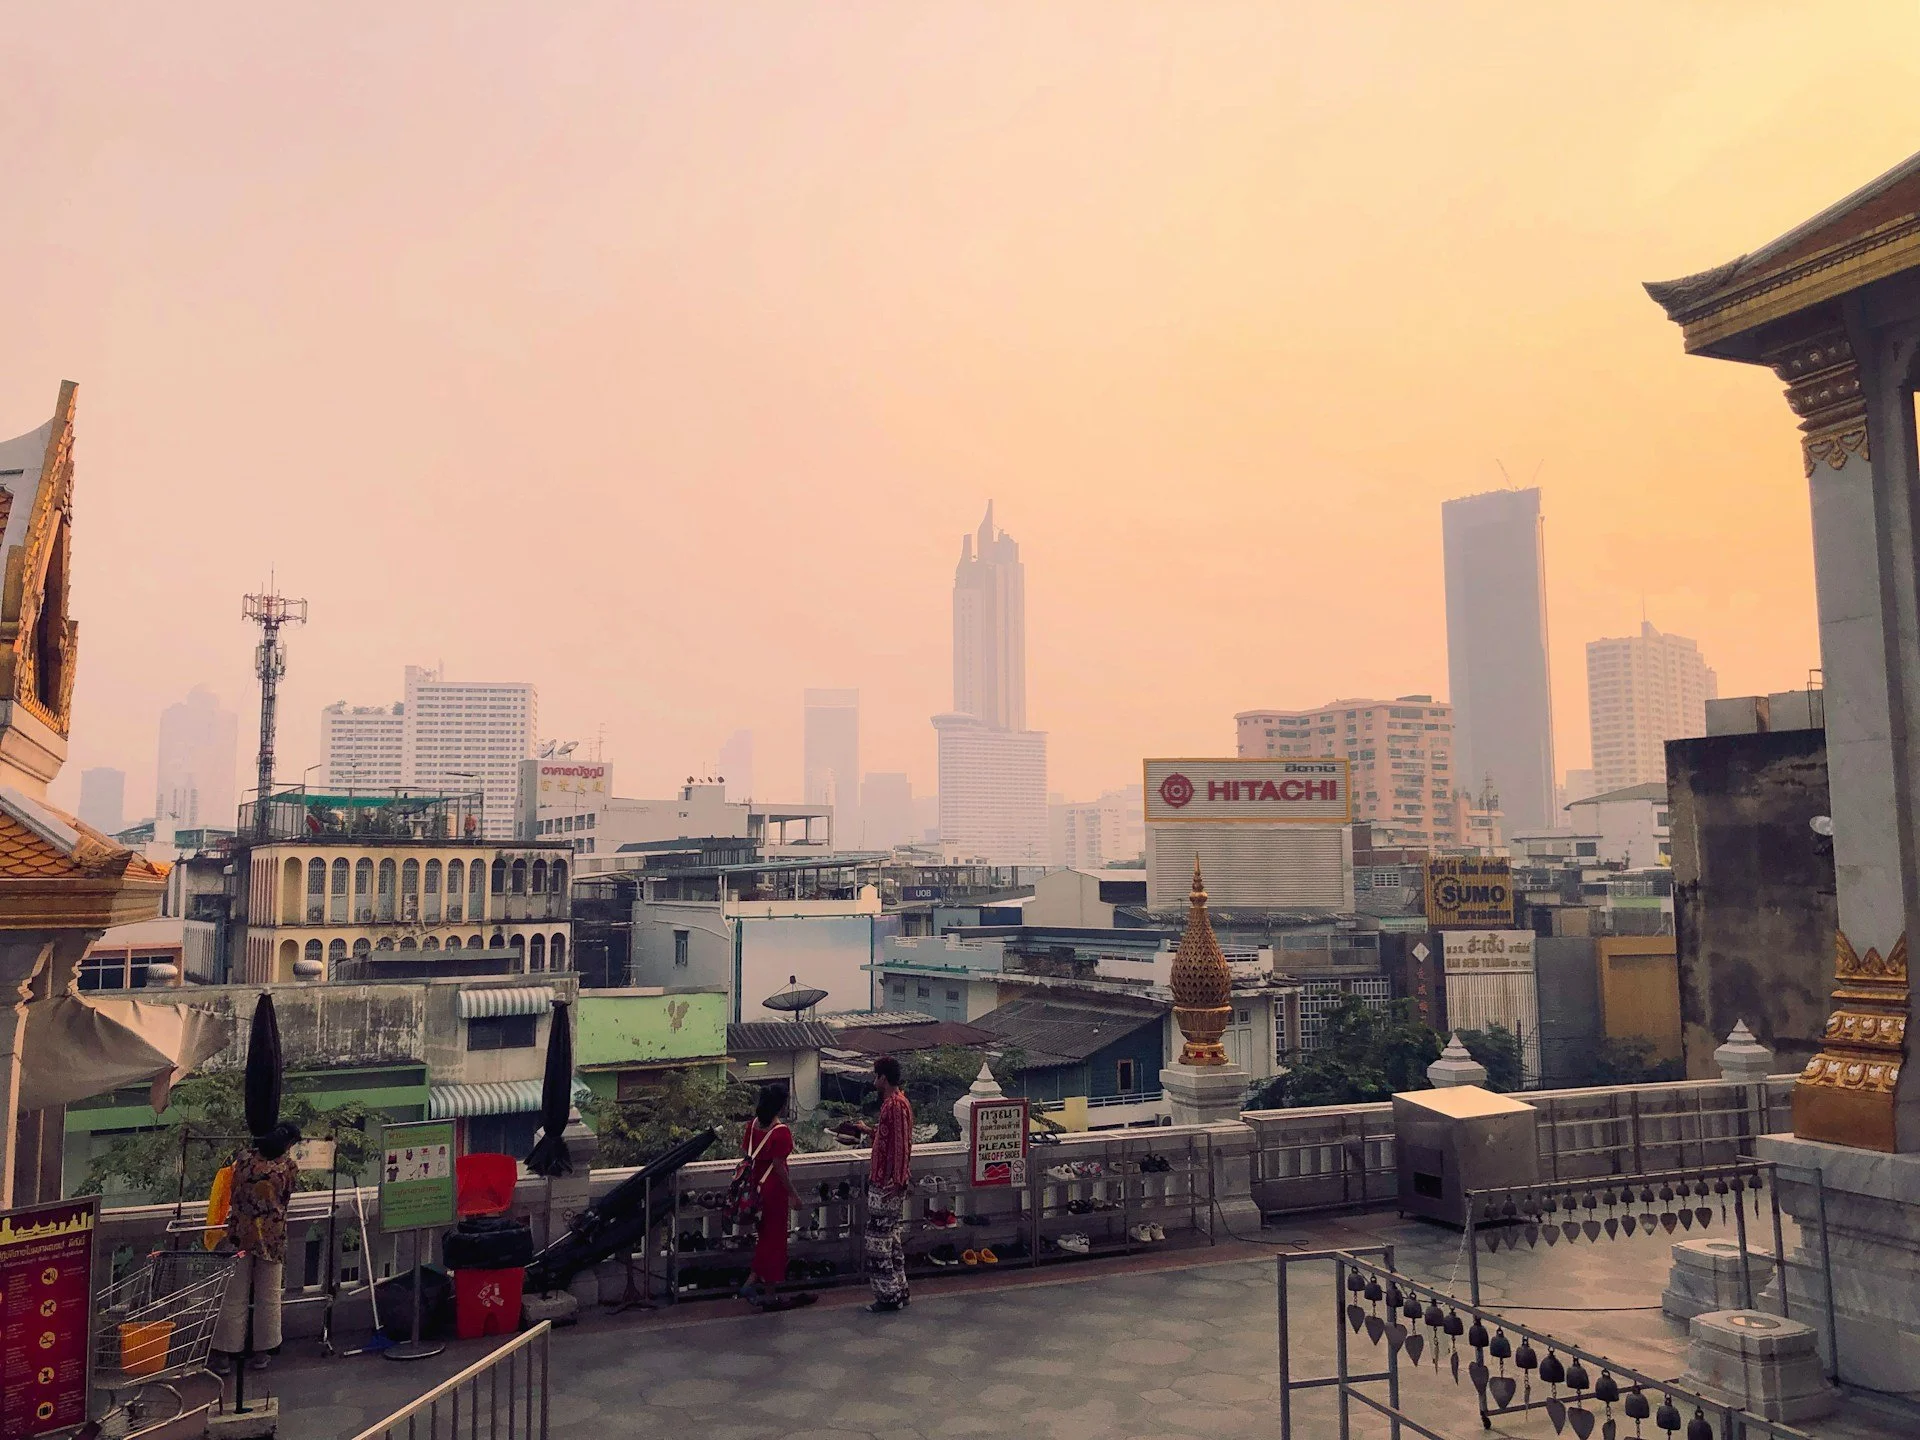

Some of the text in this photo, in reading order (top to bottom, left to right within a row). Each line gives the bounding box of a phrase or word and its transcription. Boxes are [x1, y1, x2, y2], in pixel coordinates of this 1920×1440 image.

[1208, 779, 1337, 801] HITACHI
[915, 889, 932, 898] UOB
[1442, 885, 1505, 903] SUMO
[980, 1108, 1020, 1124] กรุณา
[978, 1141, 1021, 1152] PLEASE
[978, 1150, 1020, 1161] TAKE OFF SHOES
